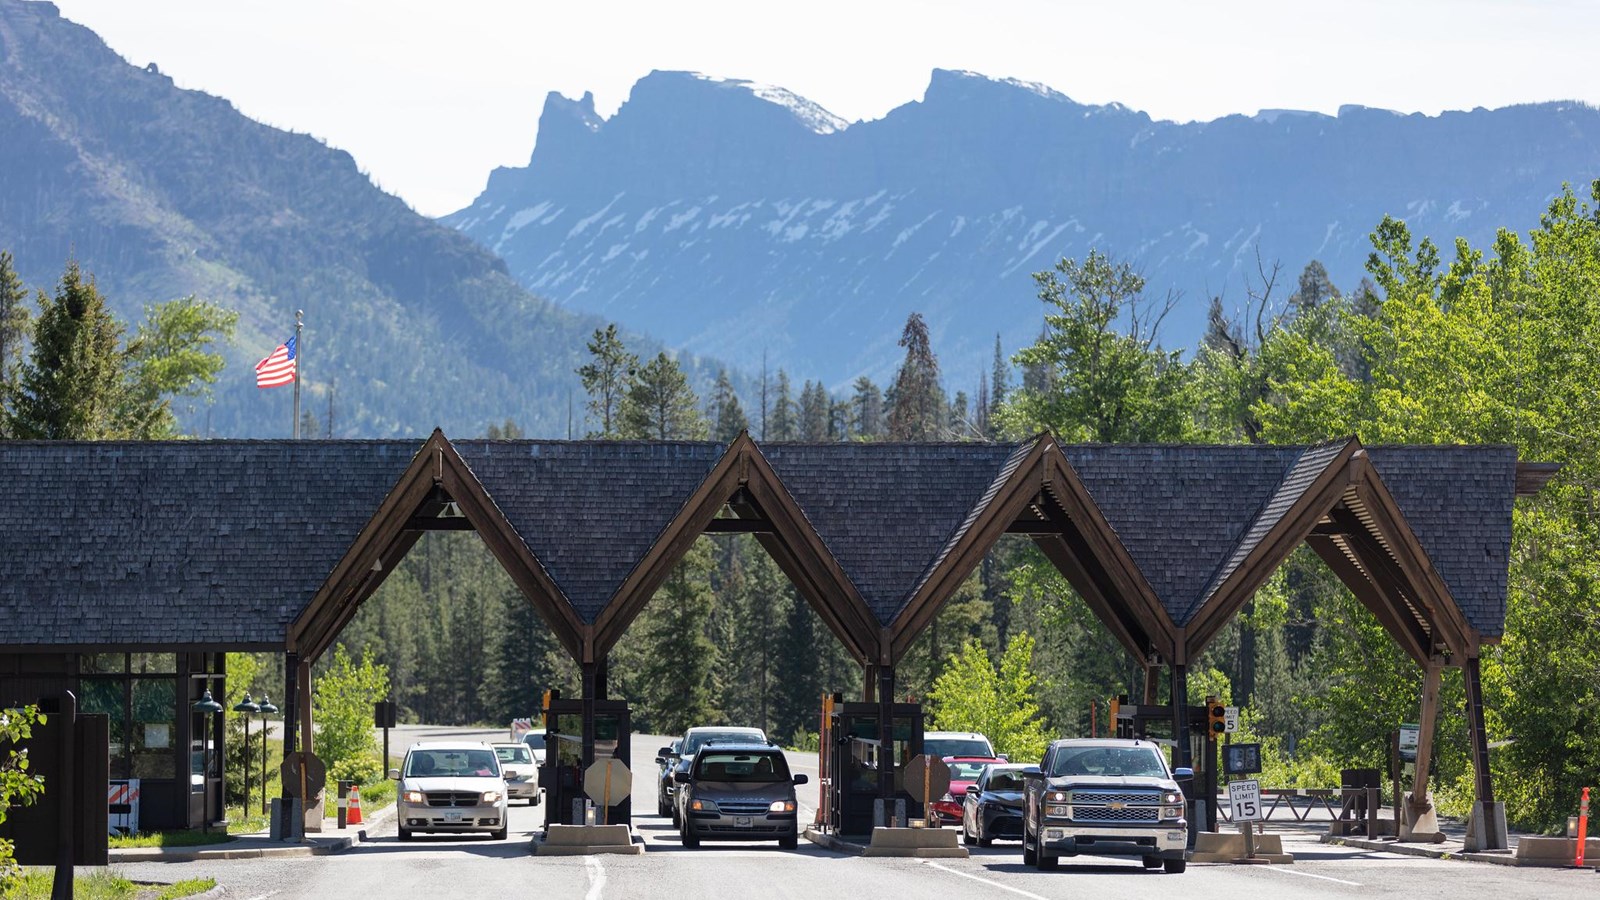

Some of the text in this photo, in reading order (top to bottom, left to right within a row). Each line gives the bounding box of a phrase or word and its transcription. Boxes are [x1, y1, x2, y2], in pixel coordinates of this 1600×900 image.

[1227, 720, 1235, 730] 5
[1231, 784, 1257, 792] SPEED
[1236, 801, 1256, 817] 15
